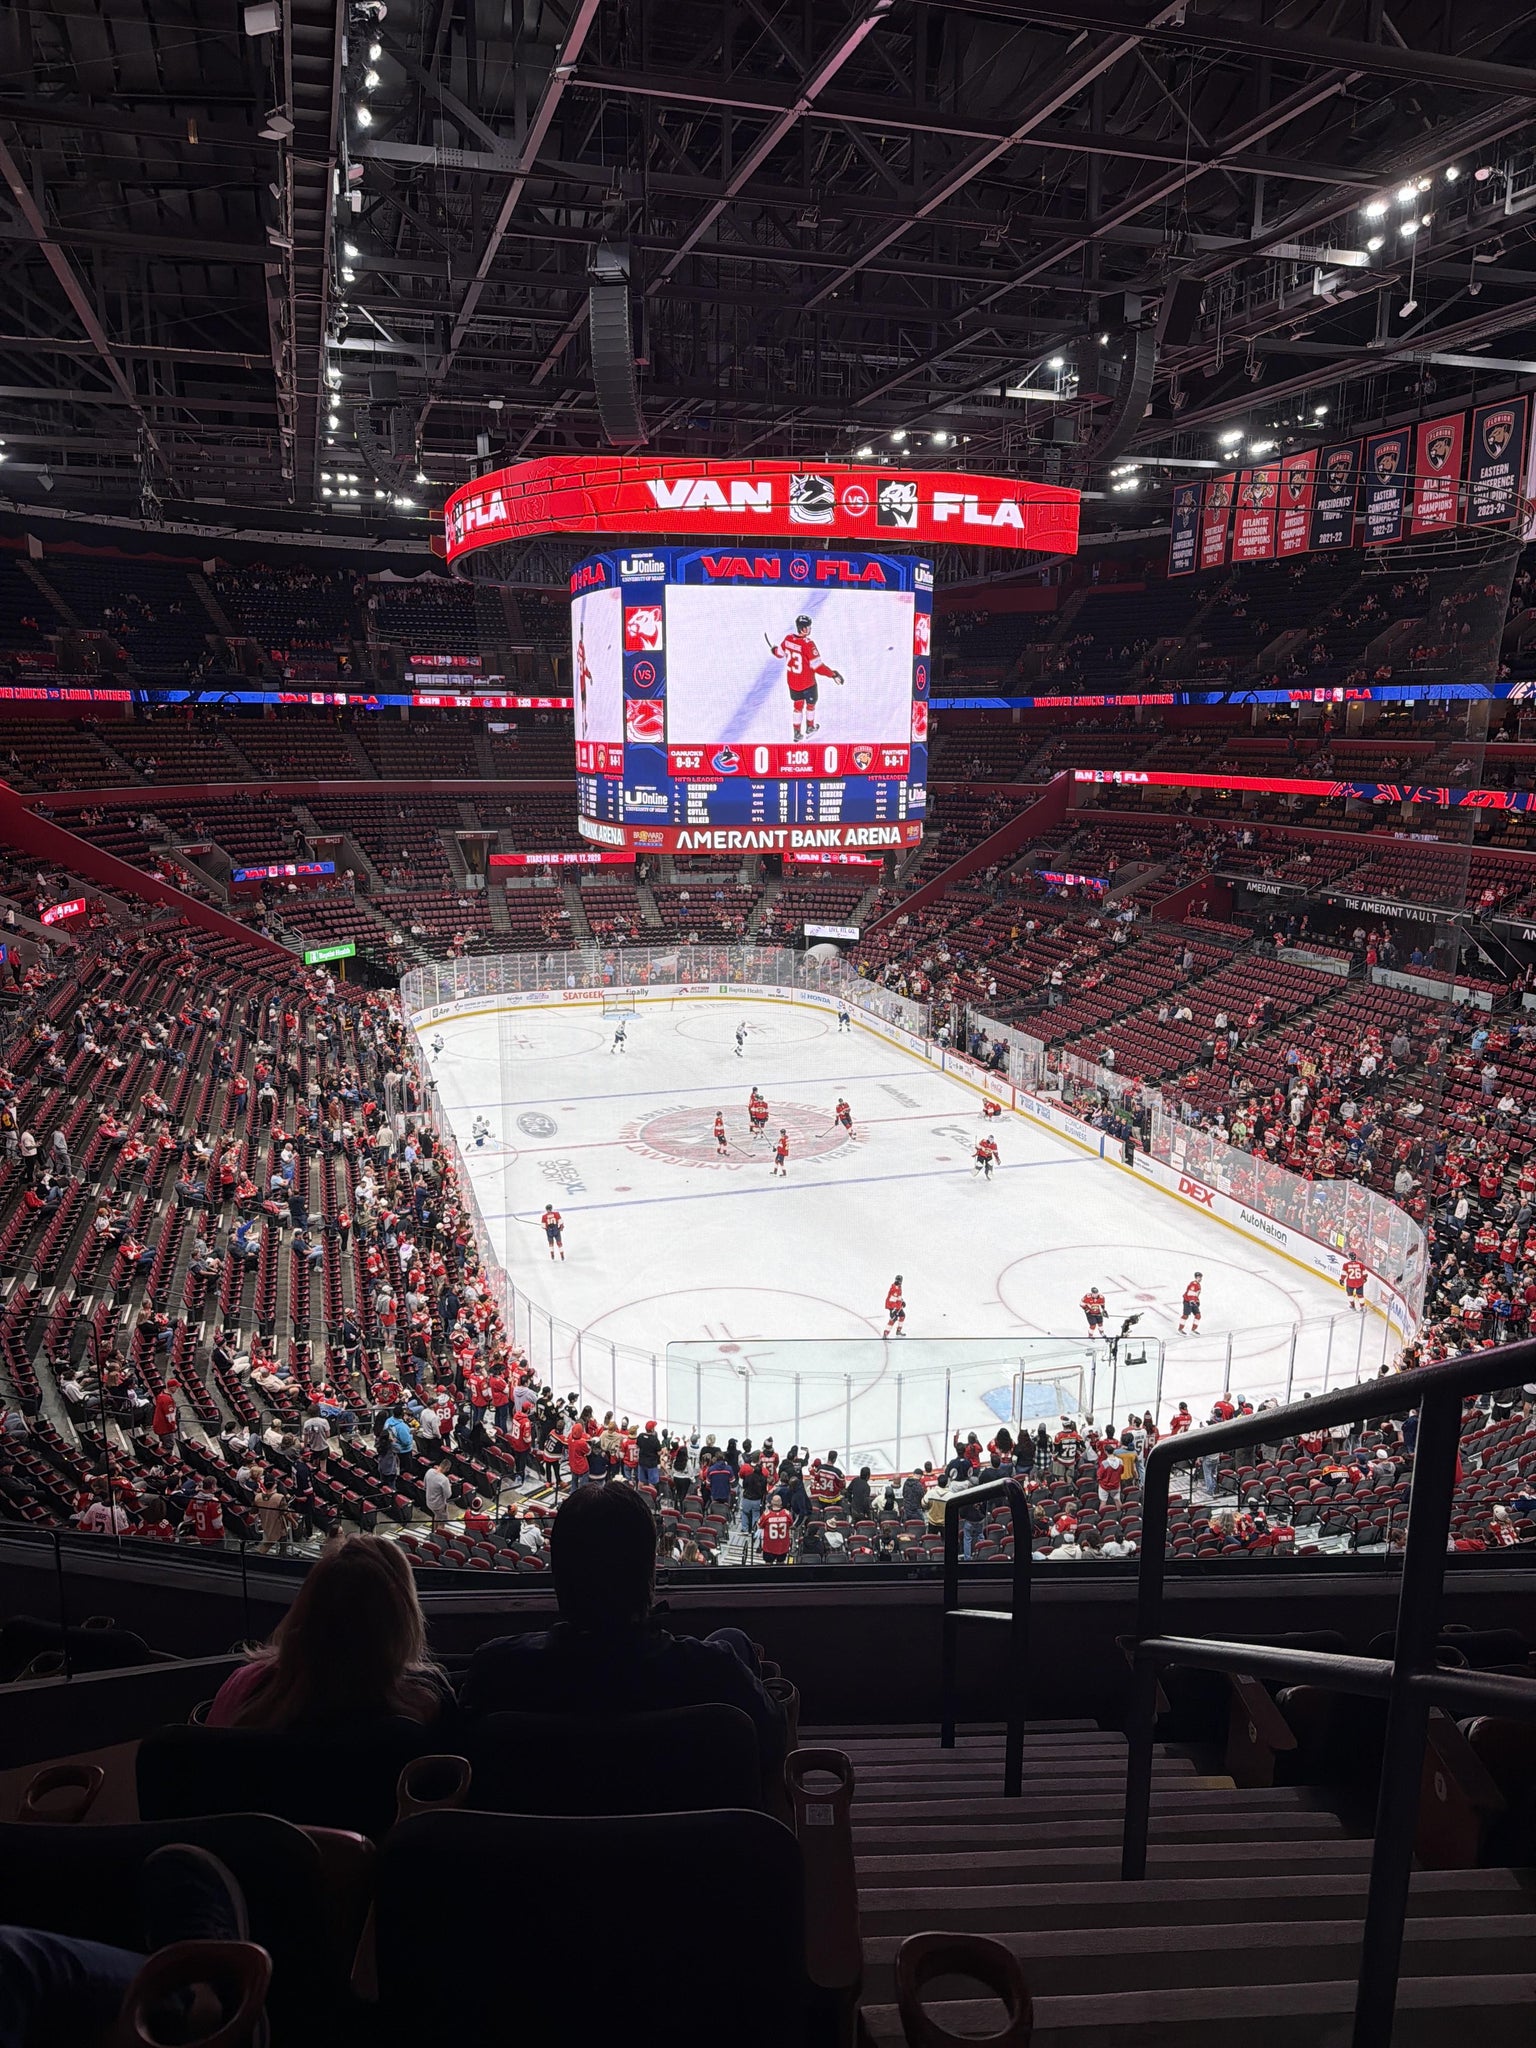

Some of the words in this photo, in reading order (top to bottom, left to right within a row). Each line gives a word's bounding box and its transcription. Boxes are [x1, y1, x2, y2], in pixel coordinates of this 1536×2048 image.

[1481, 463, 1509, 478] EASTERN
[1473, 475, 1515, 492] CONFERENCE
[1374, 489, 1396, 501] EASTERN
[1423, 488, 1450, 502] DIVISION
[465, 488, 507, 529] FLA
[646, 479, 772, 513] VAN
[848, 495, 863, 507] VS
[933, 492, 1024, 528] FLA
[1318, 496, 1353, 510] PRESIDENTS'
[1368, 499, 1400, 513] CONFERENCE
[1418, 499, 1452, 514] CHAMPIONS
[1477, 503, 1505, 517] 2023-24
[1242, 516, 1269, 527] ATLANTIC
[1242, 526, 1267, 536] DIVISION
[1281, 526, 1305, 540] CHAMPIONS
[1373, 524, 1393, 536] 2022-23
[1237, 535, 1270, 546] CHAMPIONS
[1319, 532, 1343, 543] 2021-22
[582, 563, 606, 588] FLA
[701, 557, 781, 578] VAN
[794, 565, 805, 573] VS
[816, 560, 887, 582] FLA
[785, 651, 803, 674] 23
[638, 670, 651, 680] VS
[14, 688, 48, 699] CANUCKS
[60, 689, 92, 700] FLORIDA
[94, 690, 131, 701] PANTHERS
[278, 693, 308, 702] VAN
[349, 695, 379, 703] FLA
[1034, 697, 1072, 707] VANCOUVER
[1074, 696, 1104, 706] CANUCKS
[1115, 695, 1140, 705] FLORIDA
[1141, 694, 1174, 704] PANTHERS
[1289, 690, 1312, 700] VAN
[1346, 689, 1372, 699] FLA
[755, 747, 768, 774] 0
[786, 751, 809, 764] 1:03
[824, 746, 838, 773] 0
[1125, 773, 1149, 782] FLA
[676, 830, 789, 849] AMERANT
[791, 829, 841, 848] BANK
[844, 826, 902, 846] ARENA
[245, 869, 266, 878] VAN
[298, 865, 323, 873] FLA
[1246, 882, 1281, 895] AMERANT
[64, 903, 79, 914] FLA
[1345, 898, 1359, 910] THE
[1360, 901, 1404, 918] AMERANT
[1405, 909, 1438, 924] VAULT
[563, 990, 604, 1001] SEATGEEK
[807, 995, 831, 1004] HONDA
[1065, 1125, 1087, 1142] BUSINESS
[1178, 1177, 1216, 1208] DEX
[1240, 1209, 1288, 1243] AutoNation
[1348, 1269, 1362, 1279] 26
[1061, 1445, 1077, 1457] 72
[819, 1478, 834, 1492] 34
[196, 1512, 206, 1531] 9
[769, 1524, 787, 1540] 63
